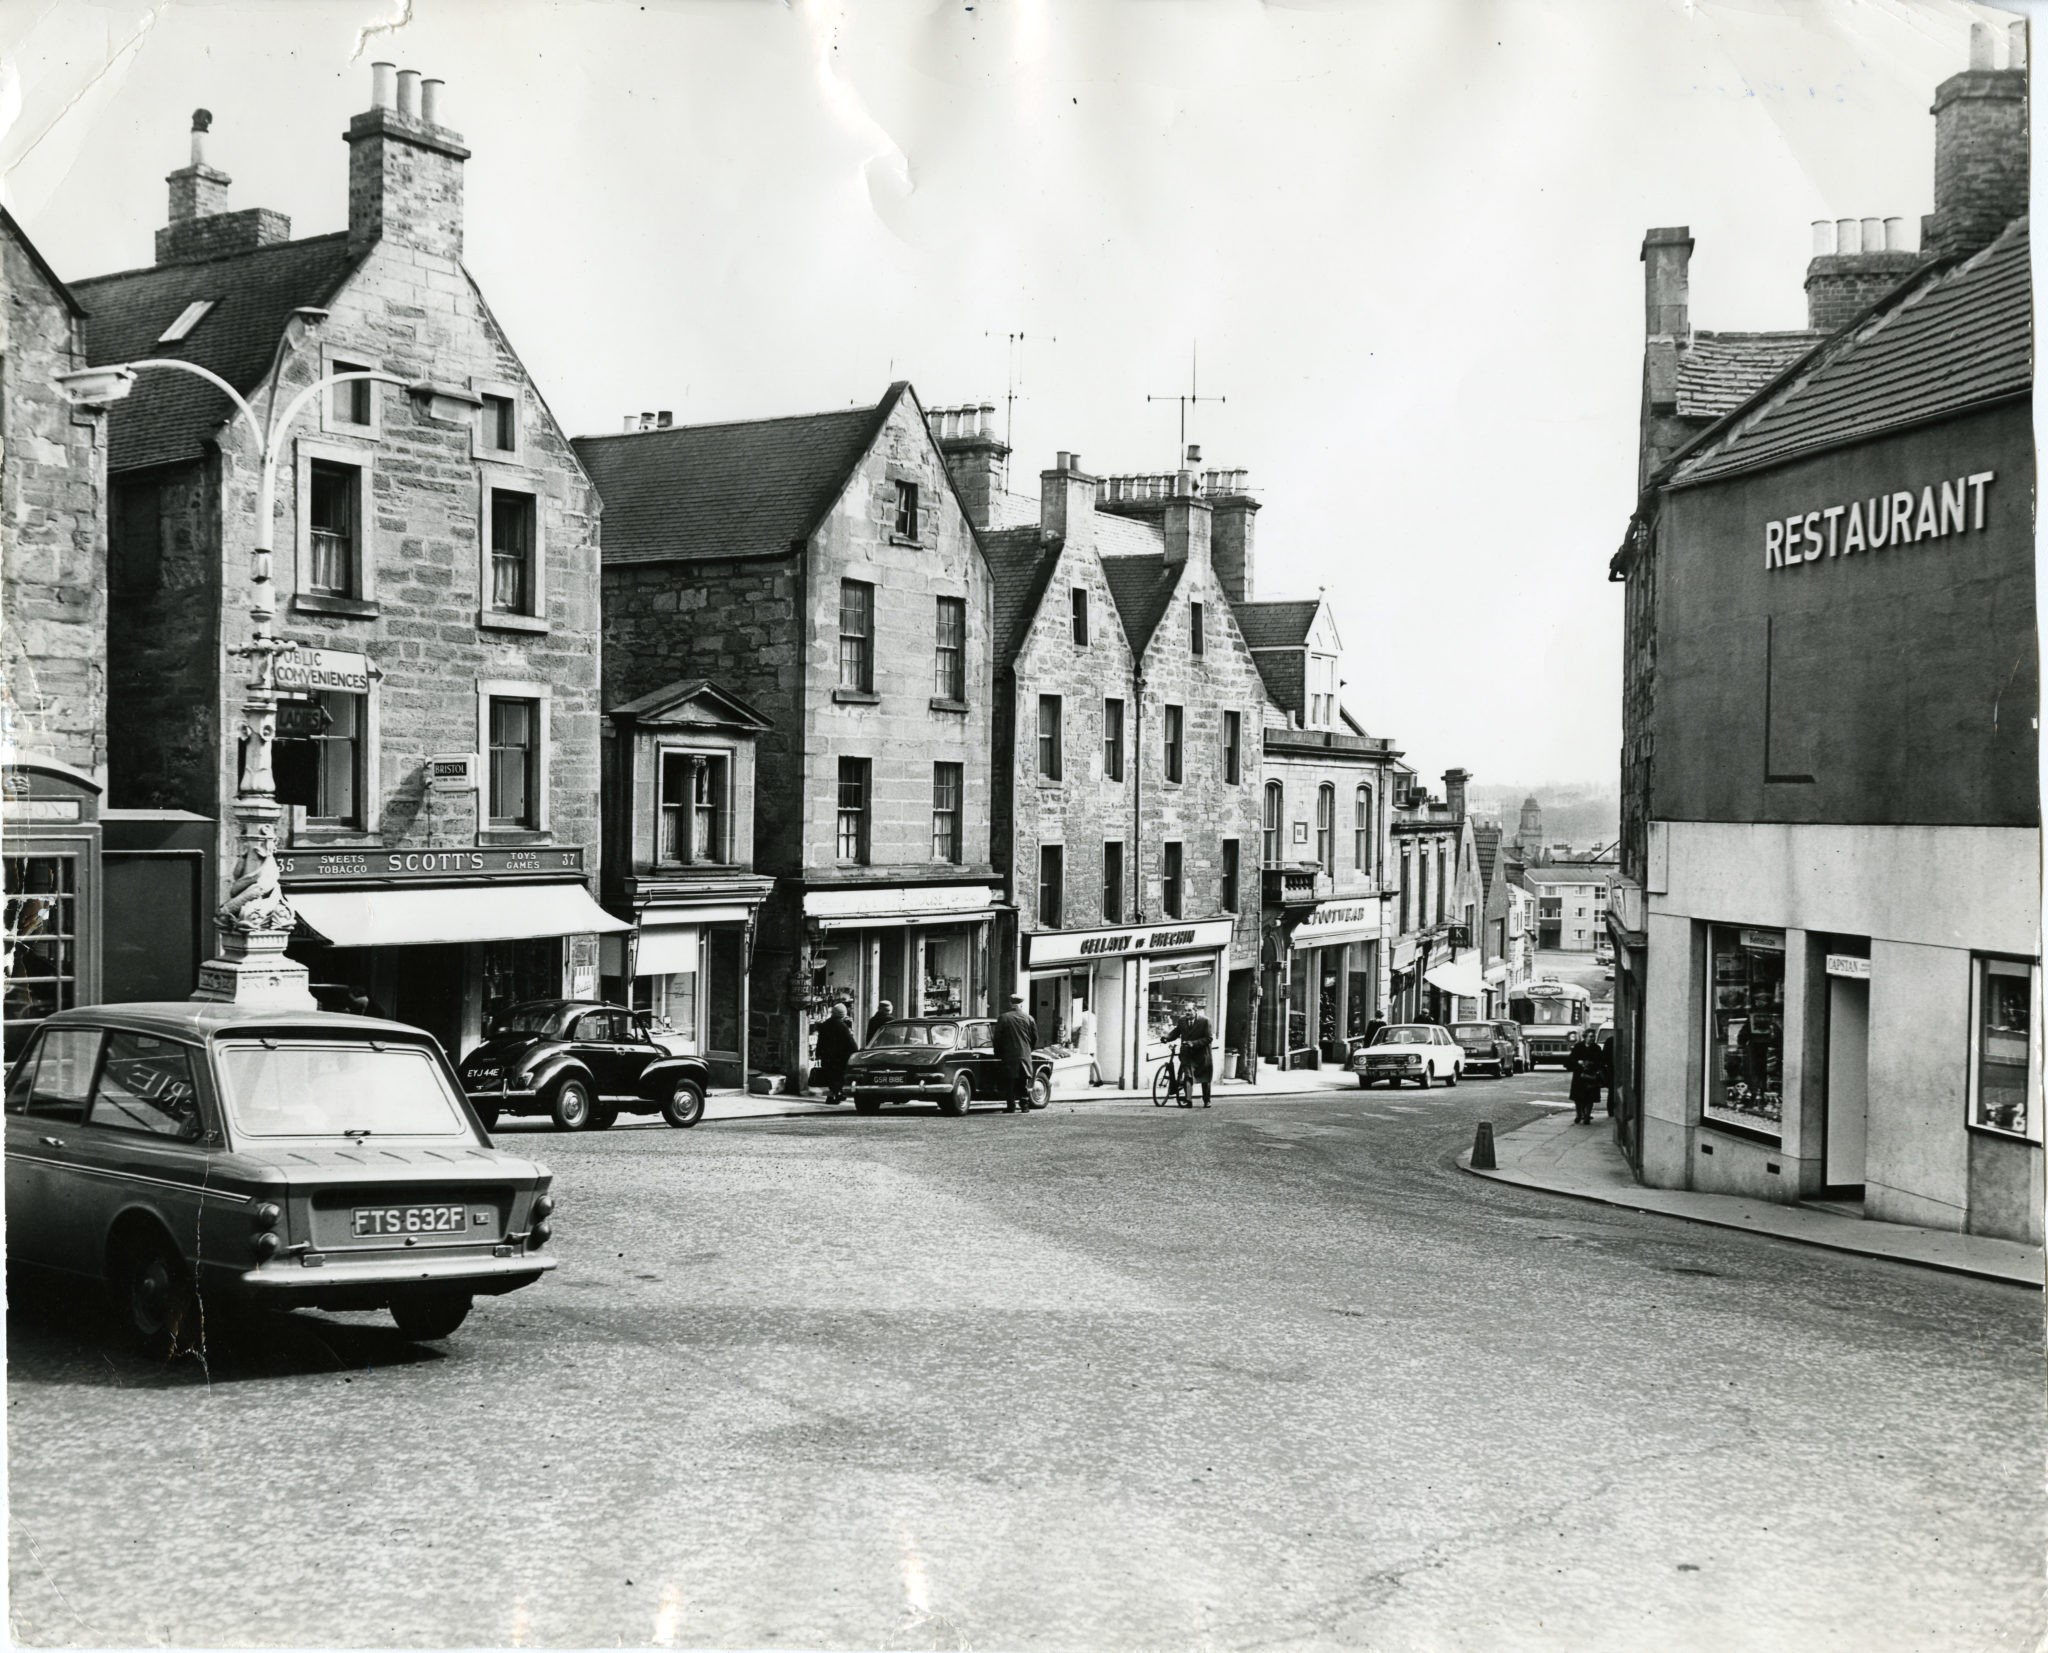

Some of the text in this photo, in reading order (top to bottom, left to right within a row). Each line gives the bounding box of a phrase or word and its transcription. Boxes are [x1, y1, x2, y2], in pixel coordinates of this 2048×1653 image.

[1766, 471, 1994, 569] RESTAURANT
[283, 651, 322, 666] UBLIC
[277, 667, 367, 690] CONVENIENCES
[279, 708, 319, 728] LADIES
[435, 764, 466, 774] BRISTOL
[321, 855, 365, 864] SWEETS
[388, 852, 484, 871] SCOTT'S
[511, 852, 537, 860] TOYS
[562, 853, 576, 865] 37
[278, 858, 294, 872] 35
[318, 865, 368, 874] TOBACCO
[506, 861, 540, 869] GAMES
[1455, 928, 1463, 938] K
[1080, 936, 1132, 954] GELLATLY
[1149, 930, 1195, 947] BRECHIN
[1828, 957, 1858, 973] CAPSTAN
[467, 1068, 500, 1077] EYJ 44E
[355, 1206, 464, 1234] FTS 632F
